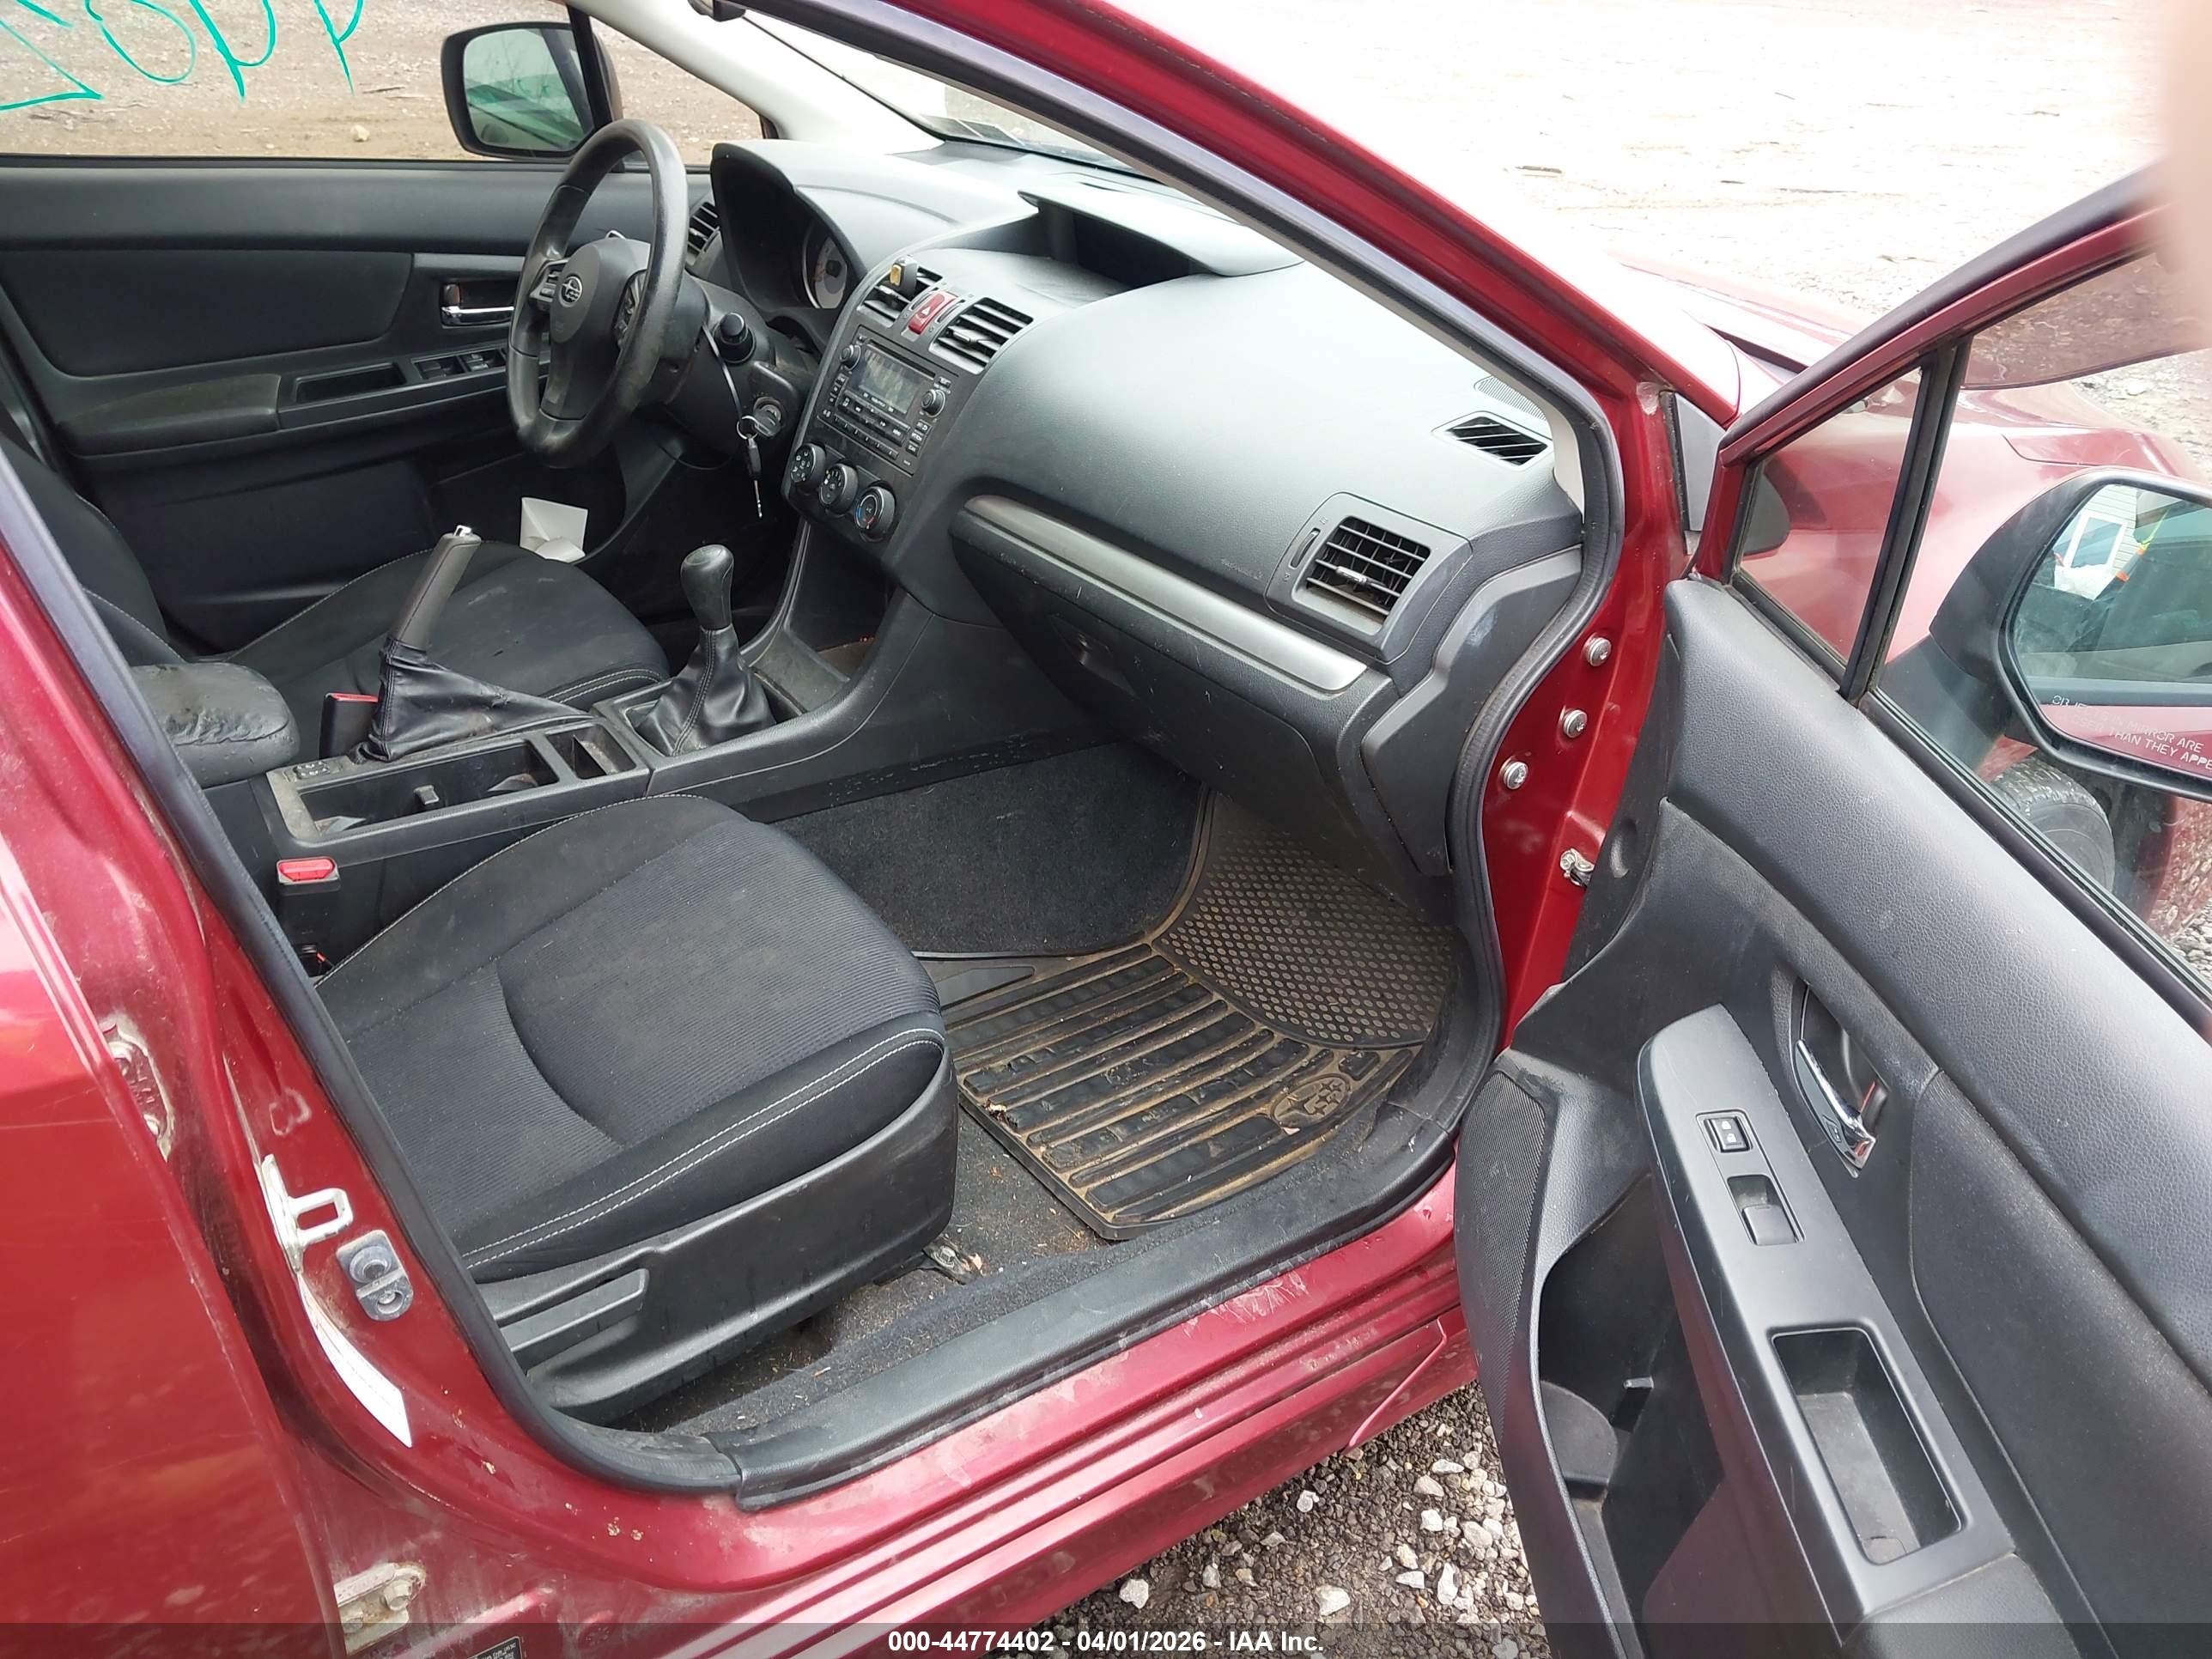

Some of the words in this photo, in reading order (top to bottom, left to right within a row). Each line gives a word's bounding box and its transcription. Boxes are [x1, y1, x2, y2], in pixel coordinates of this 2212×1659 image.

[2108, 727, 2142, 745] THAN
[2145, 738, 2178, 757] THEY
[2127, 720, 2175, 744] MIRROR
[2176, 738, 2204, 754] ARE
